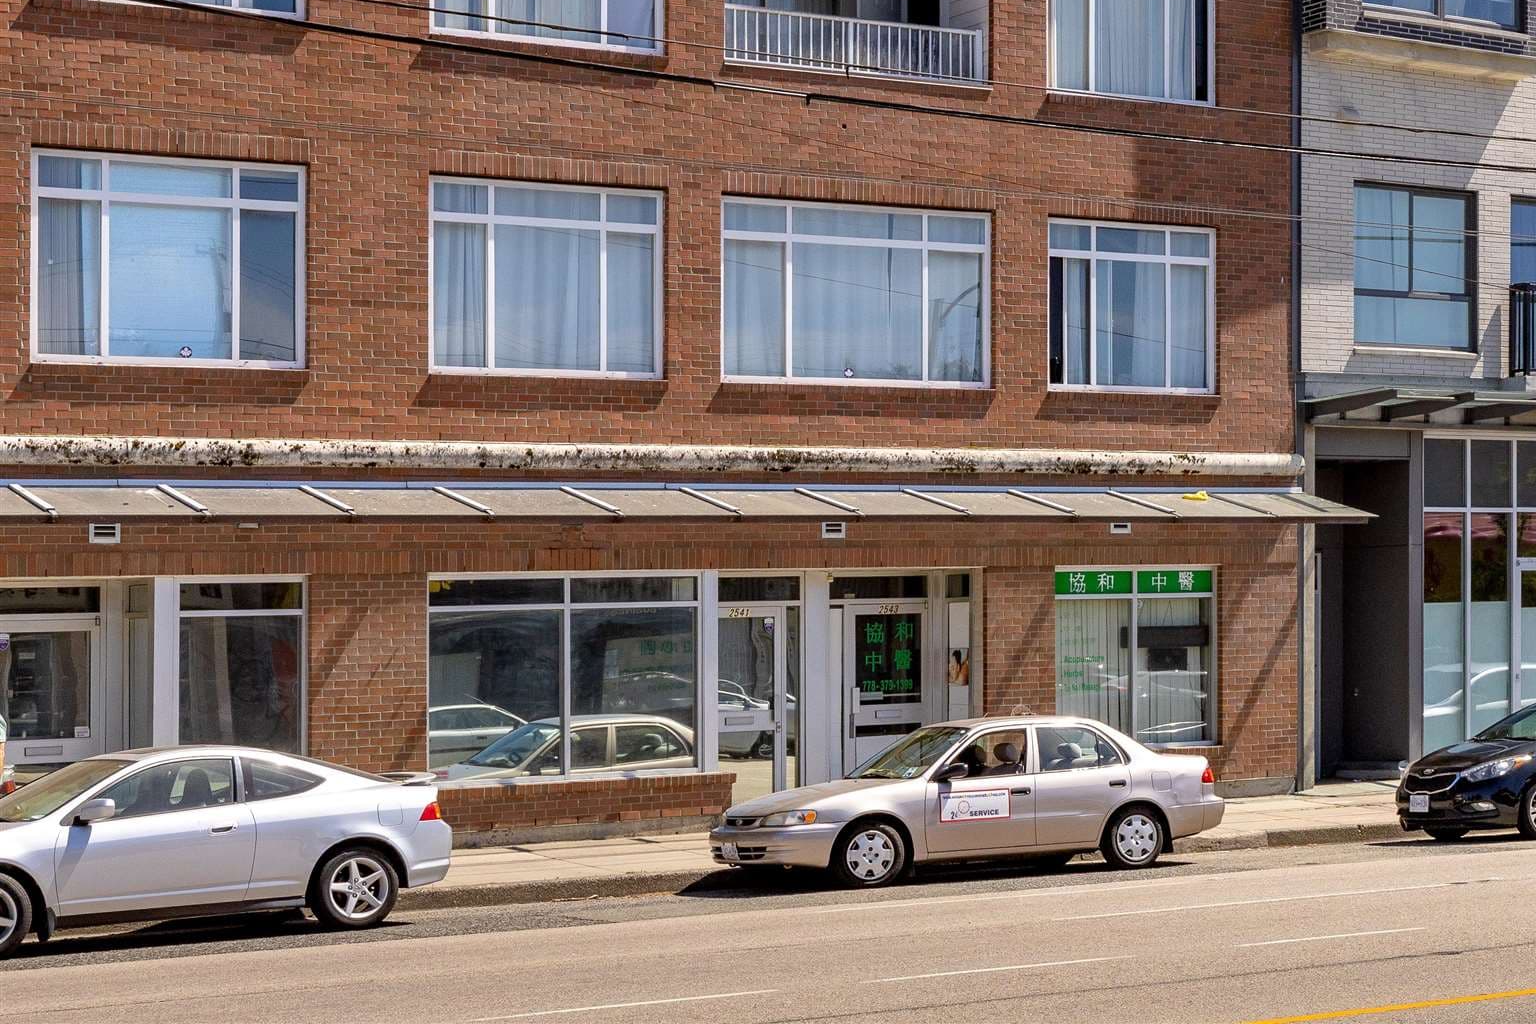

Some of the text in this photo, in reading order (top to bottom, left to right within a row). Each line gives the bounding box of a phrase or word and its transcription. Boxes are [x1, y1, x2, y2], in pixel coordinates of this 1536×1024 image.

[1069, 571, 1195, 593] 協和 中醫
[728, 607, 750, 617] 2541
[879, 605, 899, 614] 2543
[864, 622, 914, 644] 協和
[865, 649, 913, 673] 中醫
[969, 809, 1000, 817] SERVICE
